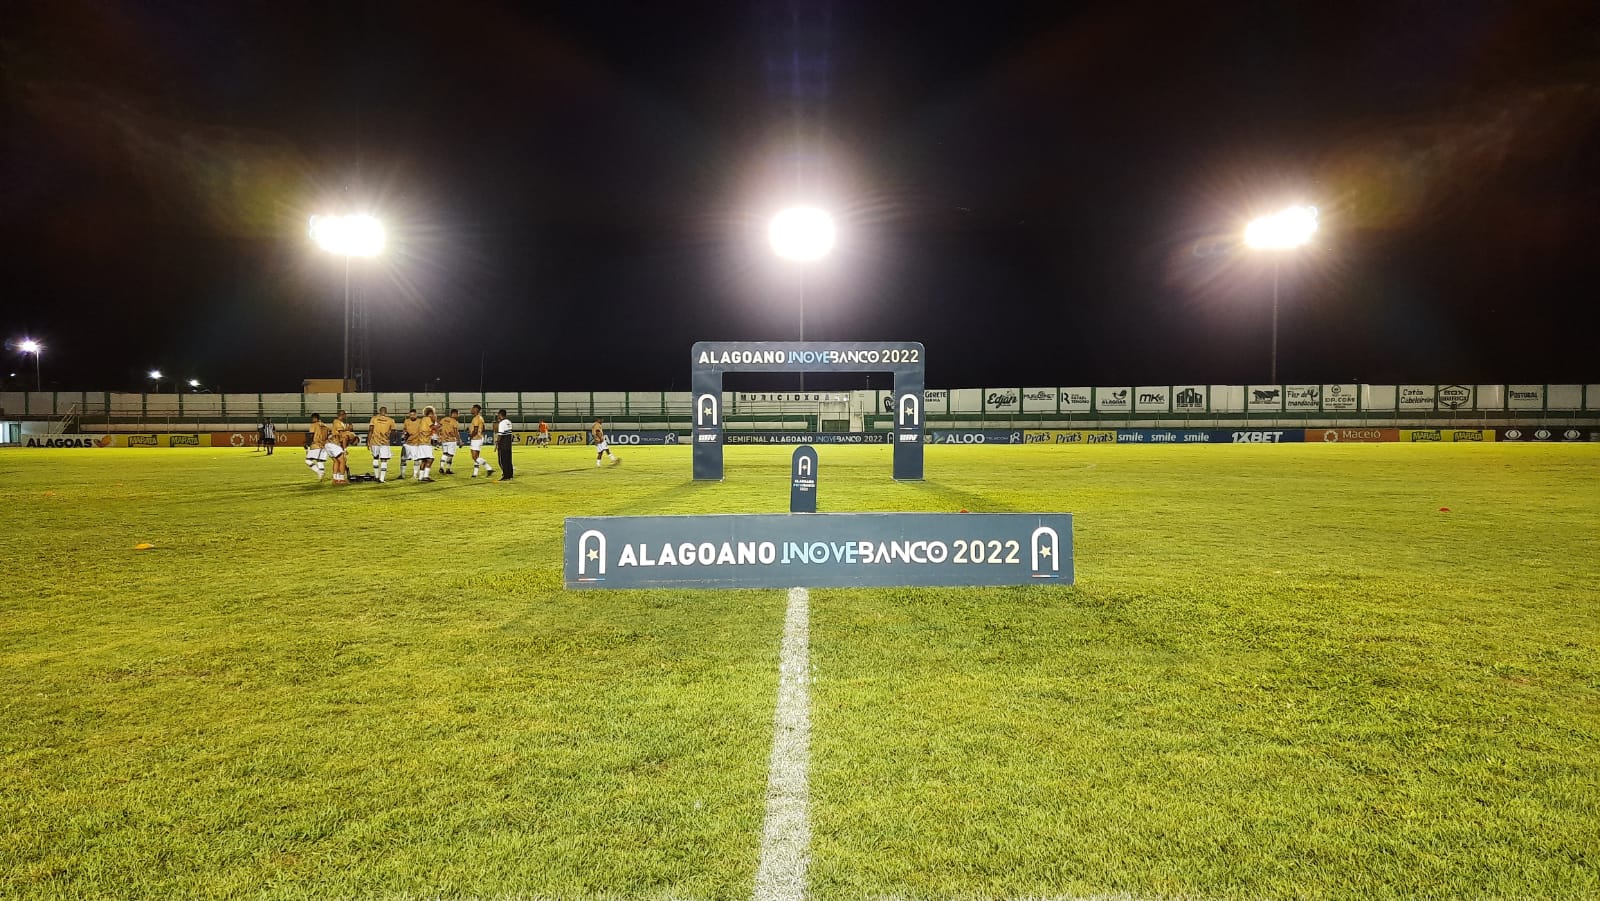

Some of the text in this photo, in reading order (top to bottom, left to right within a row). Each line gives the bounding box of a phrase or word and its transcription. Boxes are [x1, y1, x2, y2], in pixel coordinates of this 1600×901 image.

[699, 351, 785, 363] ALAGOANO
[882, 350, 918, 363] 2022
[945, 433, 985, 444] ALOO
[1118, 432, 1209, 441] smile smile smile
[1231, 431, 1283, 443] 1XBET
[26, 438, 93, 447] ALAGOAS
[618, 540, 1020, 566] ALAGOANO INOVEBANCO 2022
